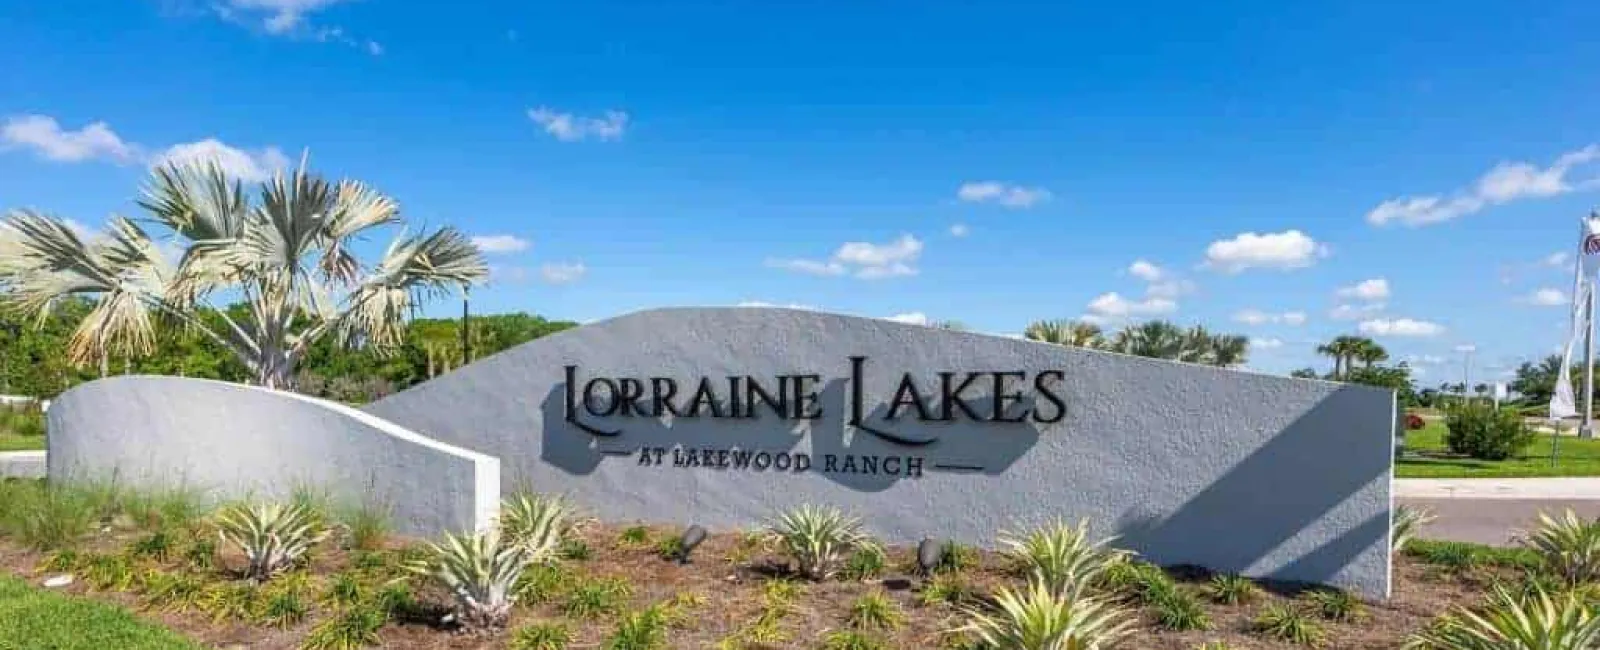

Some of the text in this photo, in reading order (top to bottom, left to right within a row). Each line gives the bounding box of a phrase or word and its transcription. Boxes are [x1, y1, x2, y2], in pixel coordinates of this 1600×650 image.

[564, 356, 1067, 445] LORRAINE LAKES
[637, 447, 924, 477] AT LAKEWOOD RANCH
